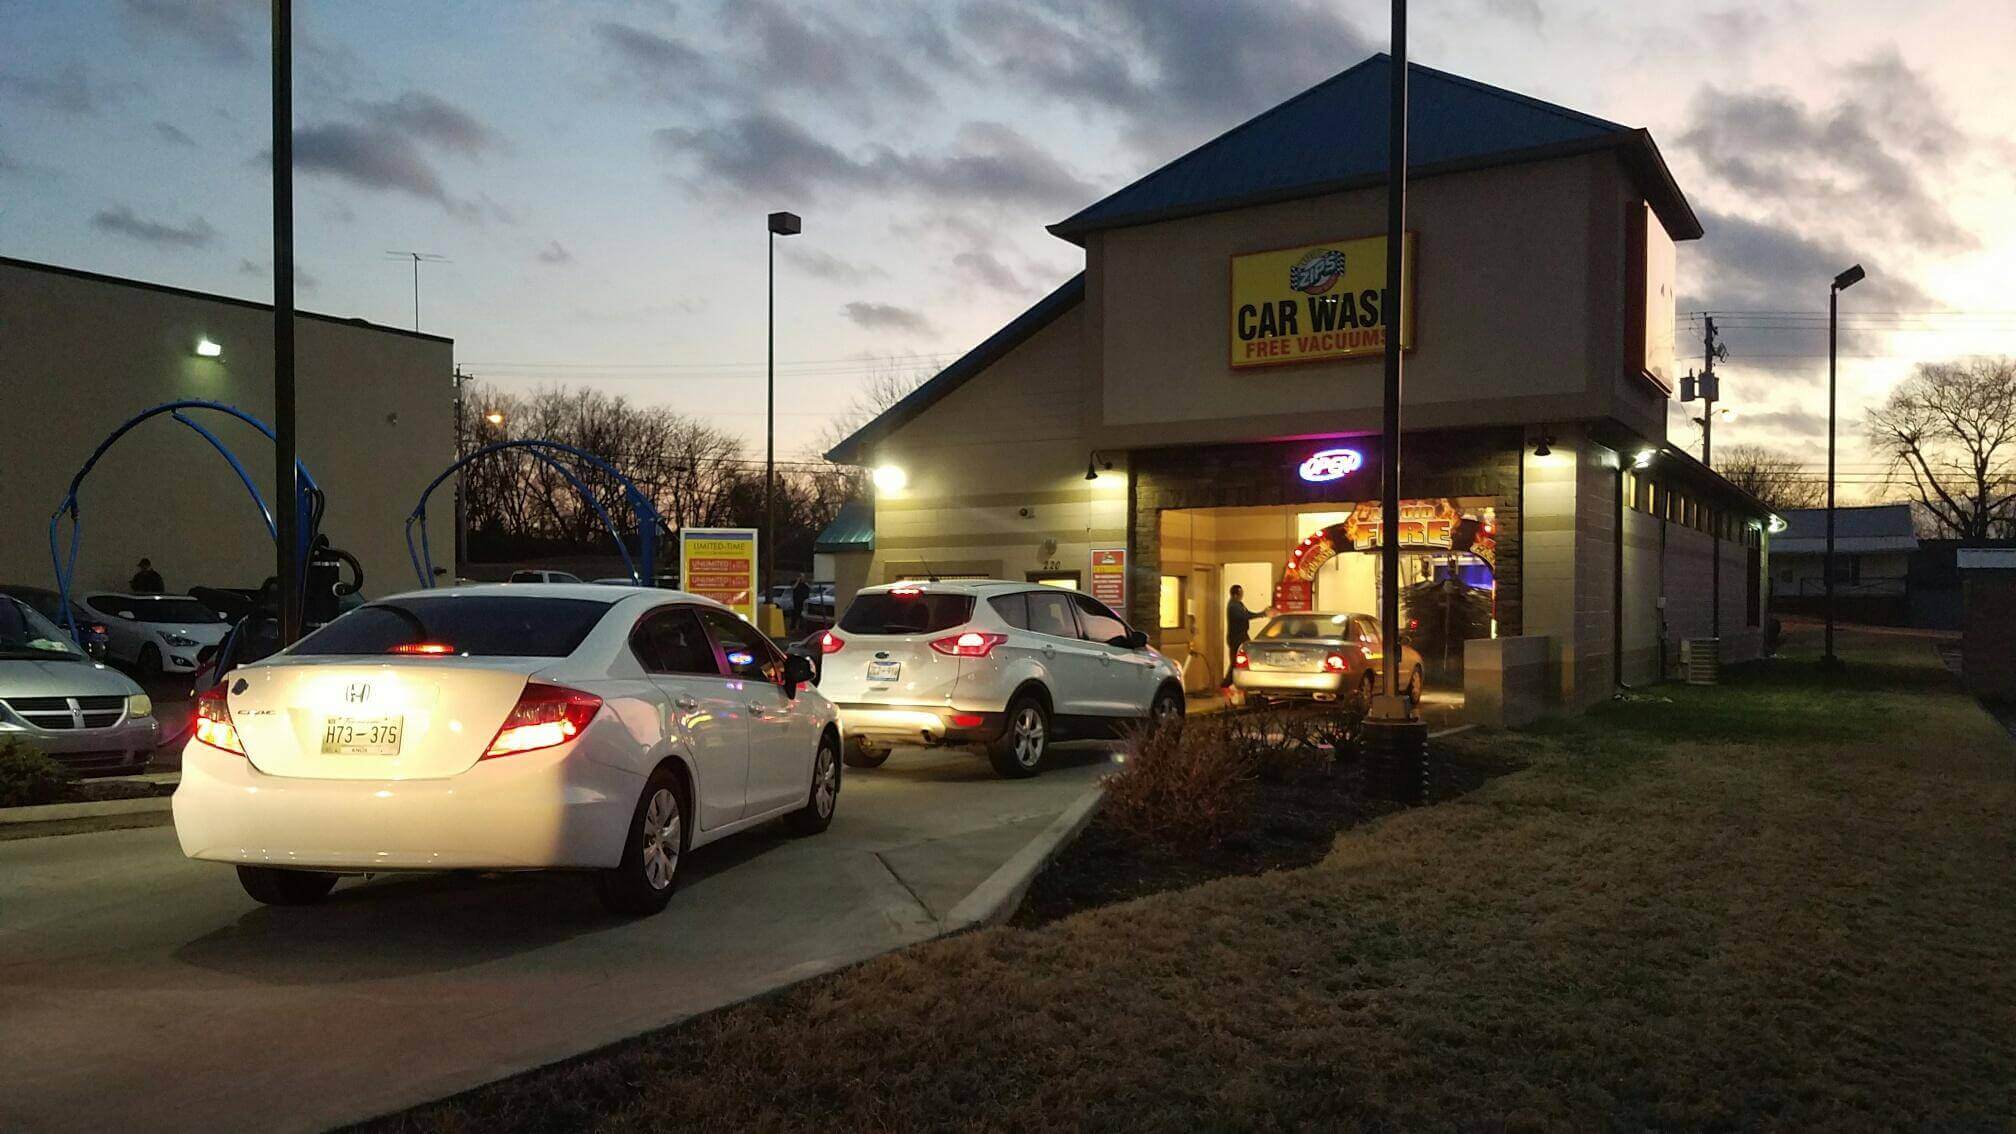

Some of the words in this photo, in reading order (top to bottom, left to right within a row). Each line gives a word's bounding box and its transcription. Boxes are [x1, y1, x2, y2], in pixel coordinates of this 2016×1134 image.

[1298, 256, 1337, 288] ZIPS
[1239, 300, 1298, 340] CAR
[1246, 341, 1290, 358] FREE
[1304, 454, 1356, 478] OPEN
[1043, 561, 1061, 570] 220
